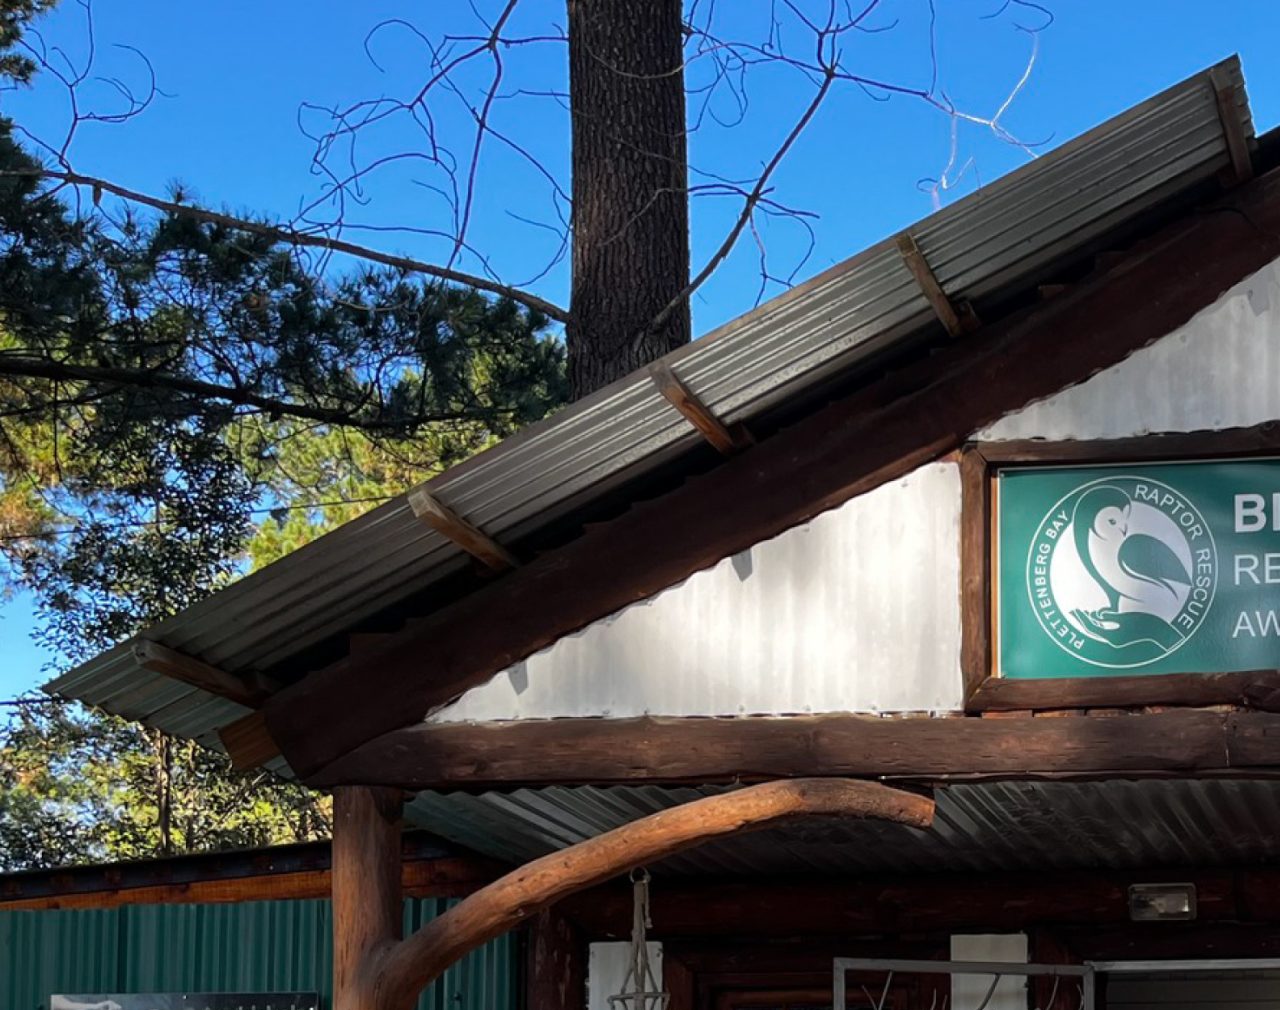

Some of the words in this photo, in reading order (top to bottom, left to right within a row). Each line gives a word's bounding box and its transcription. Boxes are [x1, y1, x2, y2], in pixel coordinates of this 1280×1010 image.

[1046, 510, 1072, 539] BAY
[1134, 484, 1203, 540] RAPTOR
[1177, 548, 1212, 630] RESCUE
[1034, 543, 1085, 650] PLETTENBERG
